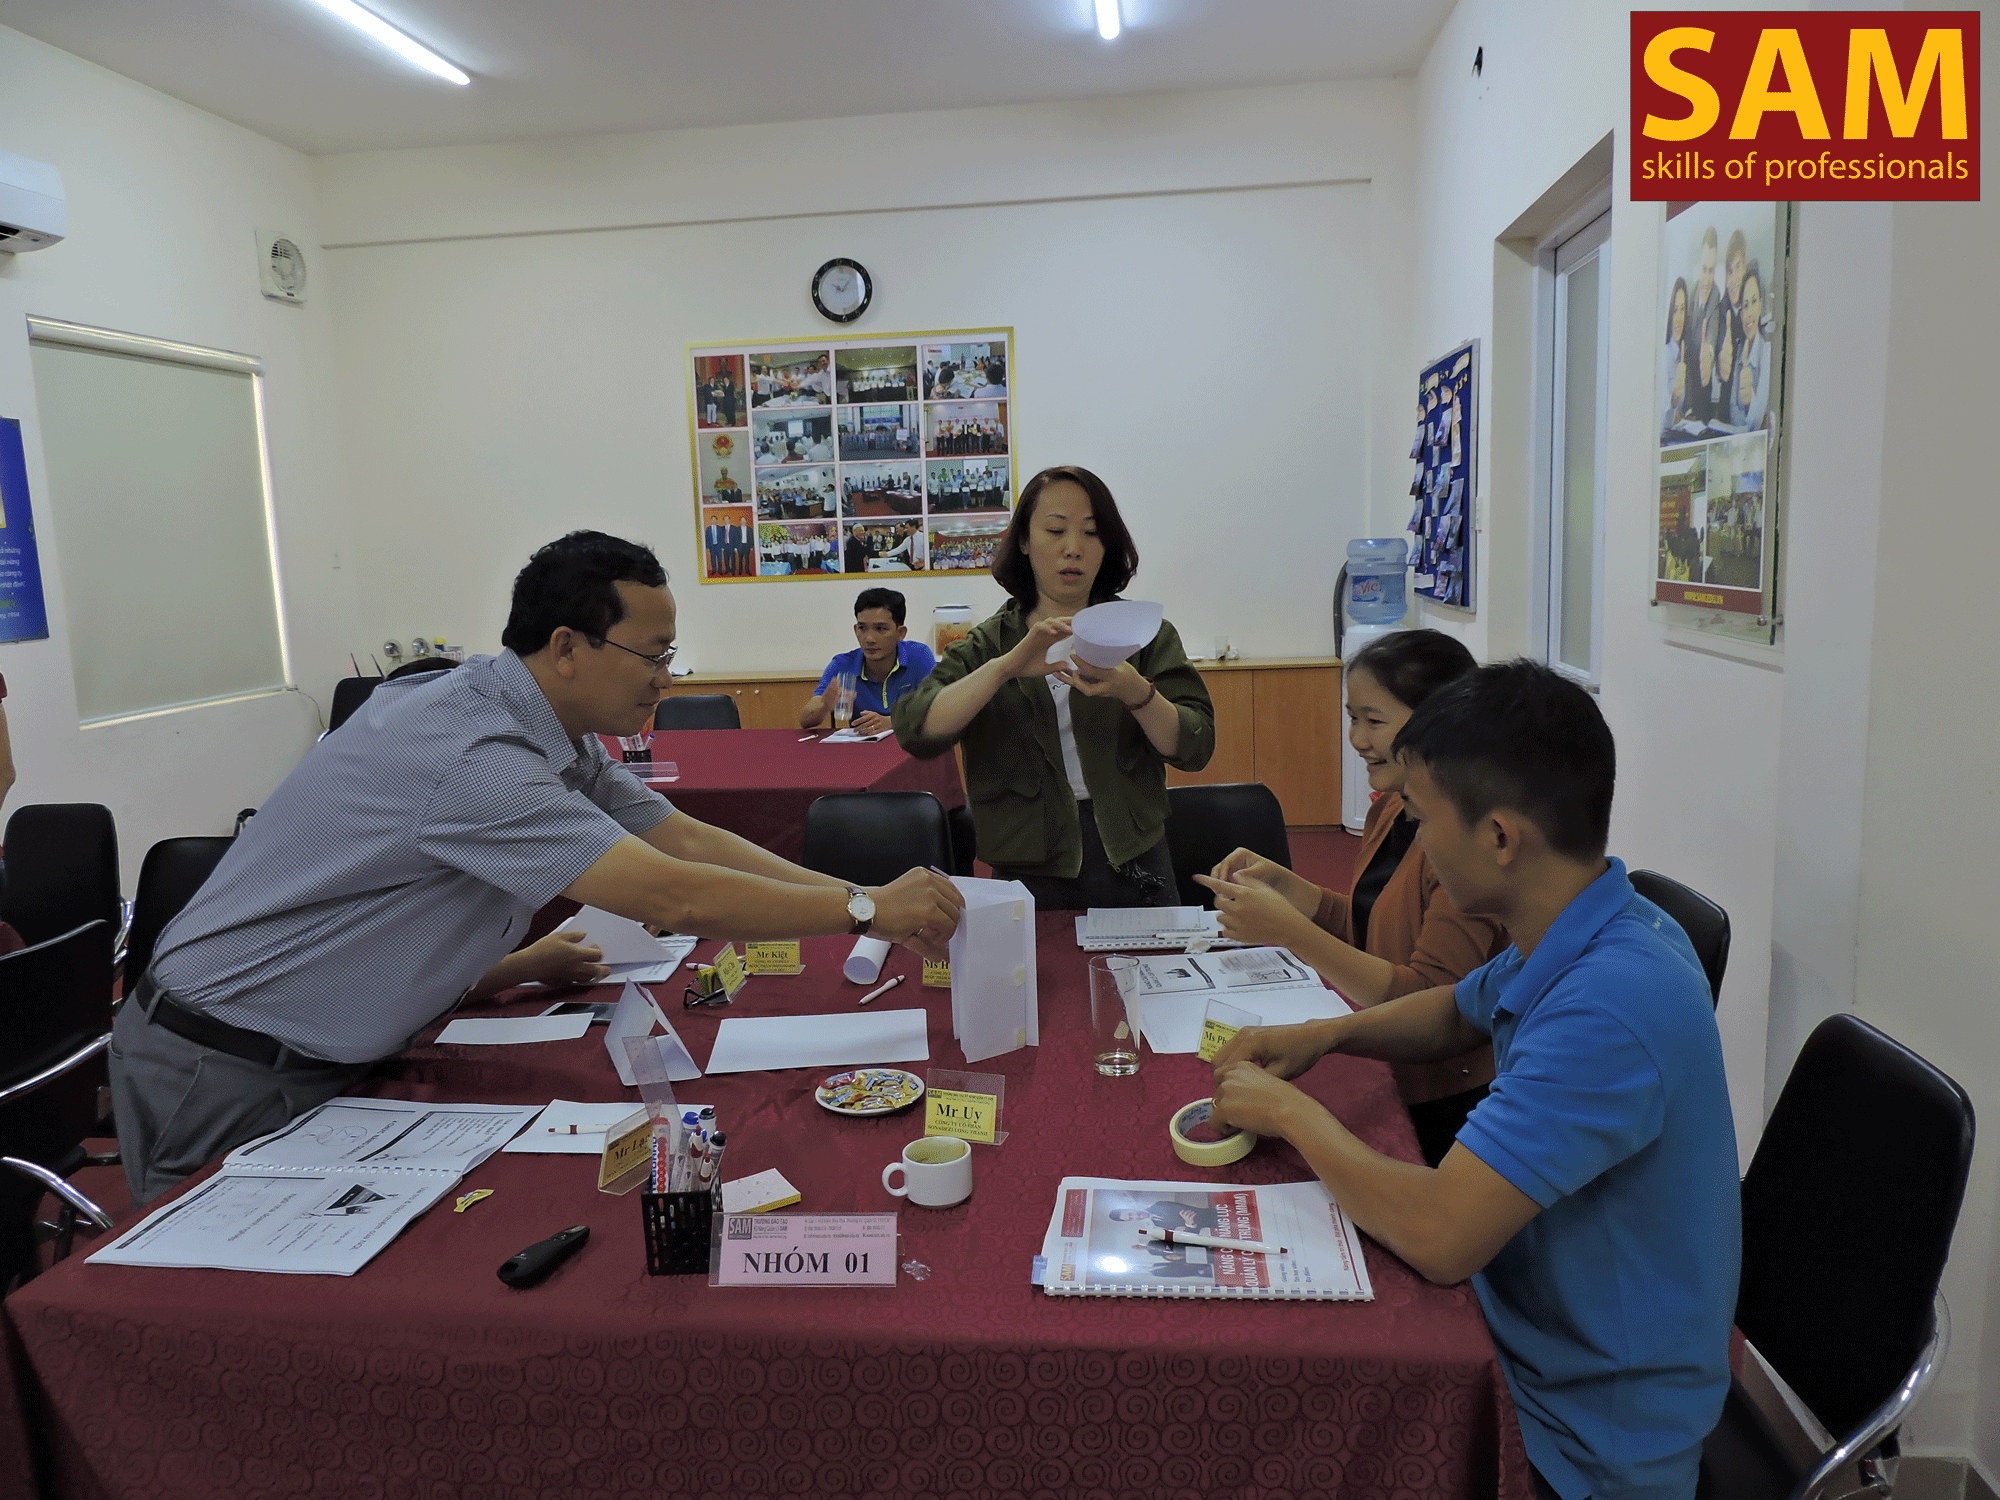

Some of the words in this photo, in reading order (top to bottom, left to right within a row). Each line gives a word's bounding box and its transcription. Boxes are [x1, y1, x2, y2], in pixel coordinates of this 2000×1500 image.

[1204, 1031, 1215, 1042] Ms
[936, 1103, 958, 1118] Mr
[615, 1147, 631, 1160] Mr
[729, 1218, 751, 1234] SAM
[1215, 1218, 1232, 1238] NĂNG
[1237, 1217, 1252, 1240] TRUNG
[743, 1246, 830, 1274] NHÓM
[845, 1252, 869, 1274] 01
[1220, 1254, 1236, 1275] NÂNG
[1238, 1257, 1256, 1265] LÝ
[1240, 1266, 1258, 1287] QUẢN
